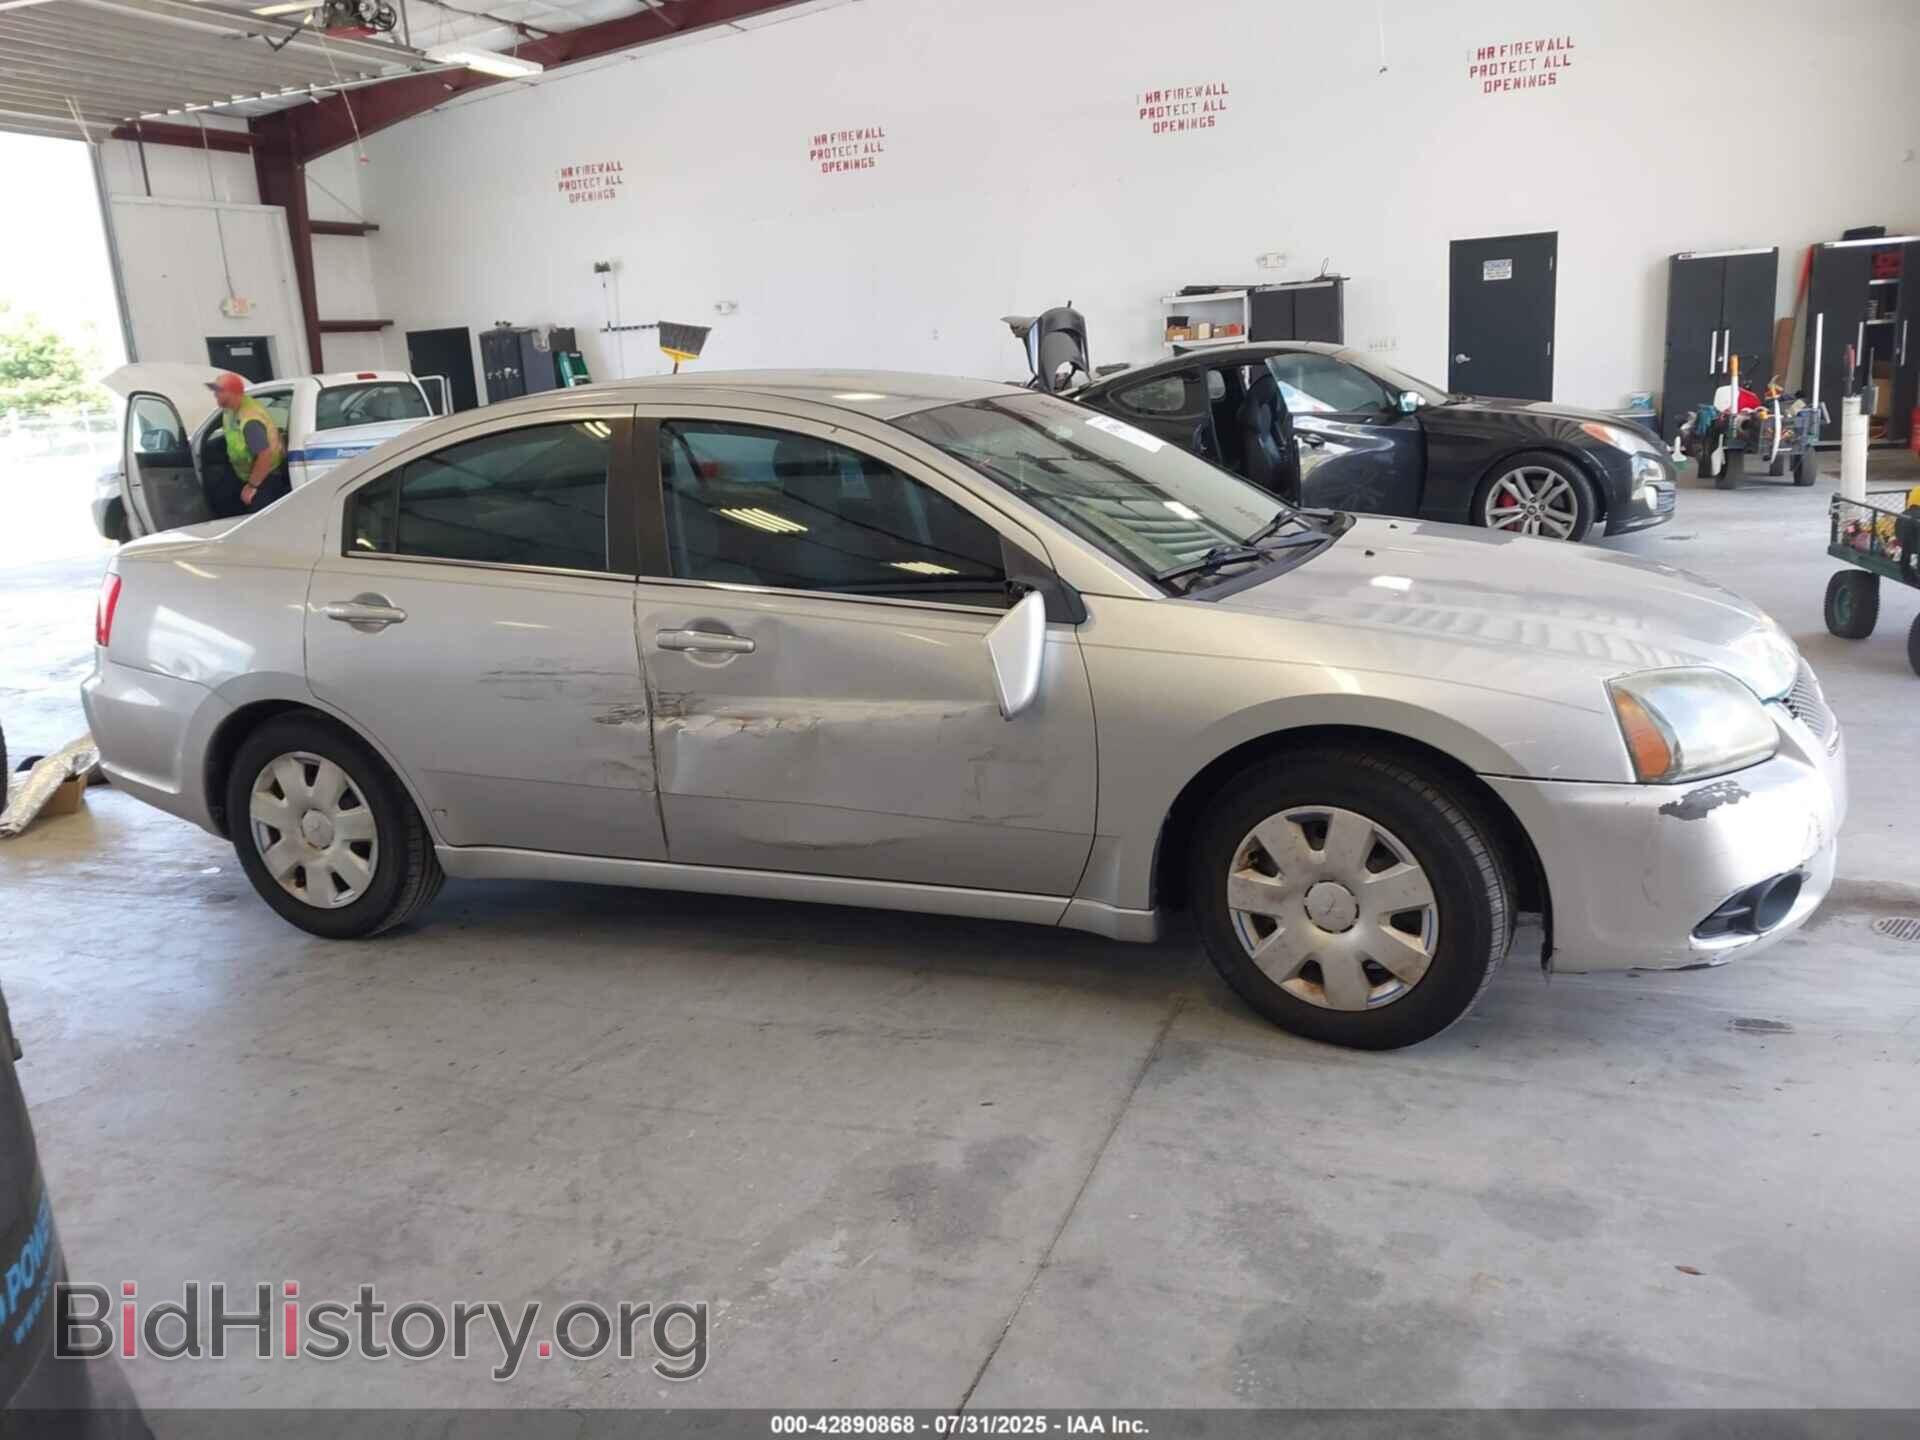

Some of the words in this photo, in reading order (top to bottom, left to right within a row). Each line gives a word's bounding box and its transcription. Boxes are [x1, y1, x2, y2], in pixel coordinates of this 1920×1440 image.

[1477, 46, 1495, 60] HR
[1500, 36, 1574, 57] FIREWALL
[1470, 58, 1536, 79] PROTECT
[1544, 54, 1572, 68] ALL
[1483, 72, 1557, 93] OPENINGS
[1145, 91, 1161, 104] HR
[1164, 82, 1229, 101] FIREWALL
[1139, 102, 1197, 120] PROTECT
[1203, 98, 1227, 112] ALL
[1152, 115, 1215, 134] OPENINGS
[814, 134, 828, 145] HR
[830, 126, 885, 143] FIREWALL
[809, 144, 858, 161] PROTECT
[863, 142, 884, 154] ALL
[576, 160, 624, 175] FIREWALL
[822, 156, 875, 173] OPENINGS
[558, 176, 601, 192] PROTECT
[605, 175, 624, 186] ALL
[568, 188, 616, 204] OPENINGS
